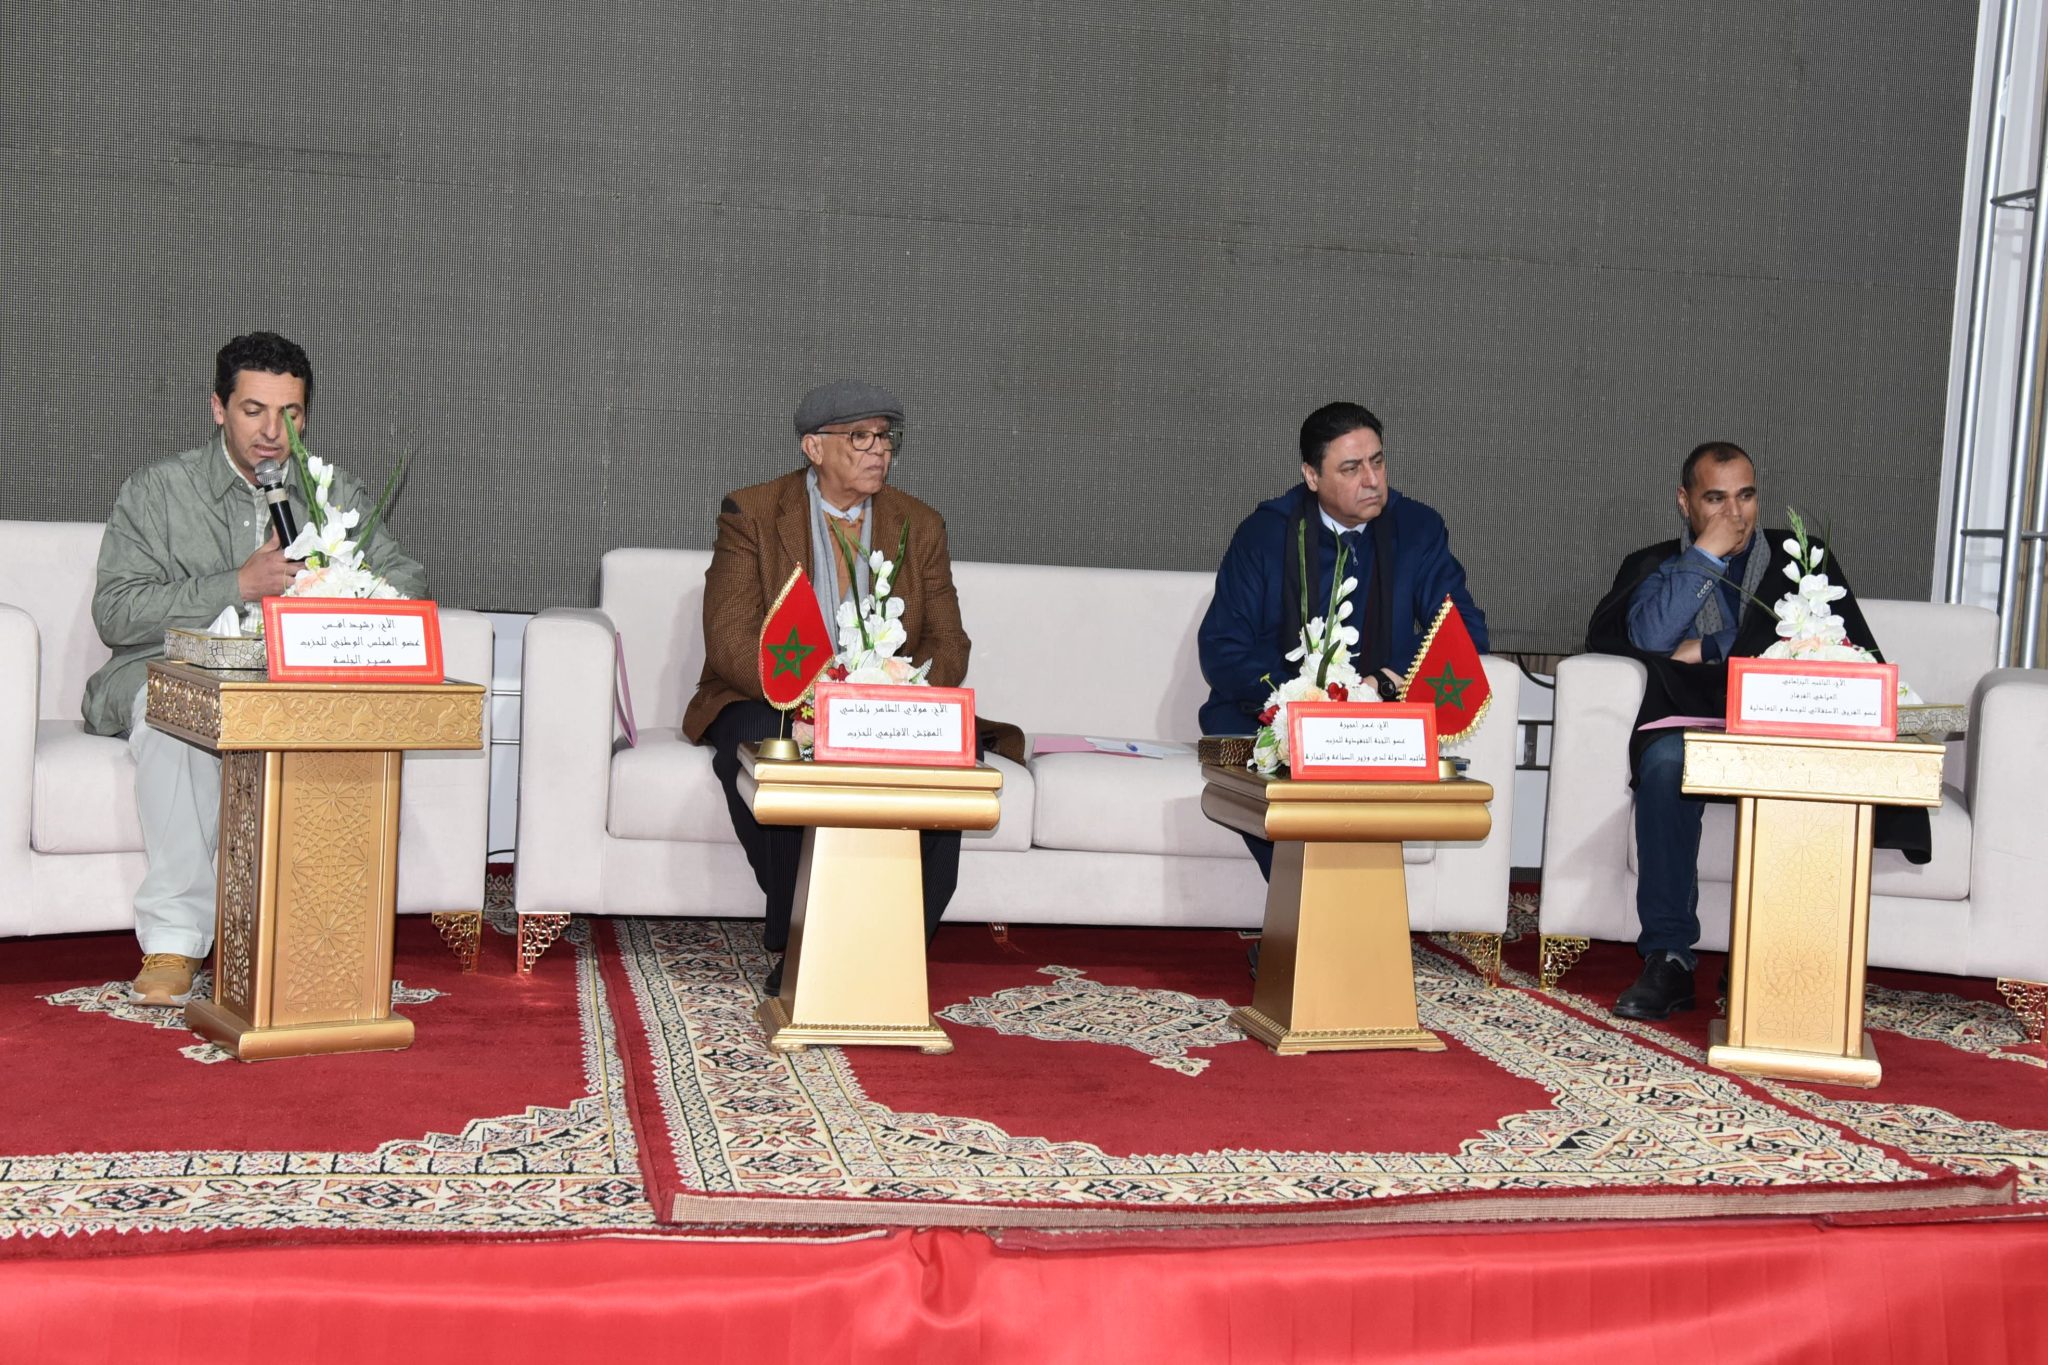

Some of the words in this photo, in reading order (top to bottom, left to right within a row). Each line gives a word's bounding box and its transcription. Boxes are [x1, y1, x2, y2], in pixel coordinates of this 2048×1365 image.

[348, 619, 374, 632] رشيد
[299, 636, 328, 649] للحزب
[330, 636, 364, 649] الوطني
[366, 636, 399, 648] المجلس
[400, 638, 421, 649] عضو
[332, 653, 362, 665] الجلسة
[366, 655, 393, 666] مسير
[873, 703, 901, 716] الطاهر
[903, 703, 928, 716] مولاي
[846, 727, 872, 739] للحزب
[911, 727, 943, 739] المفتش
